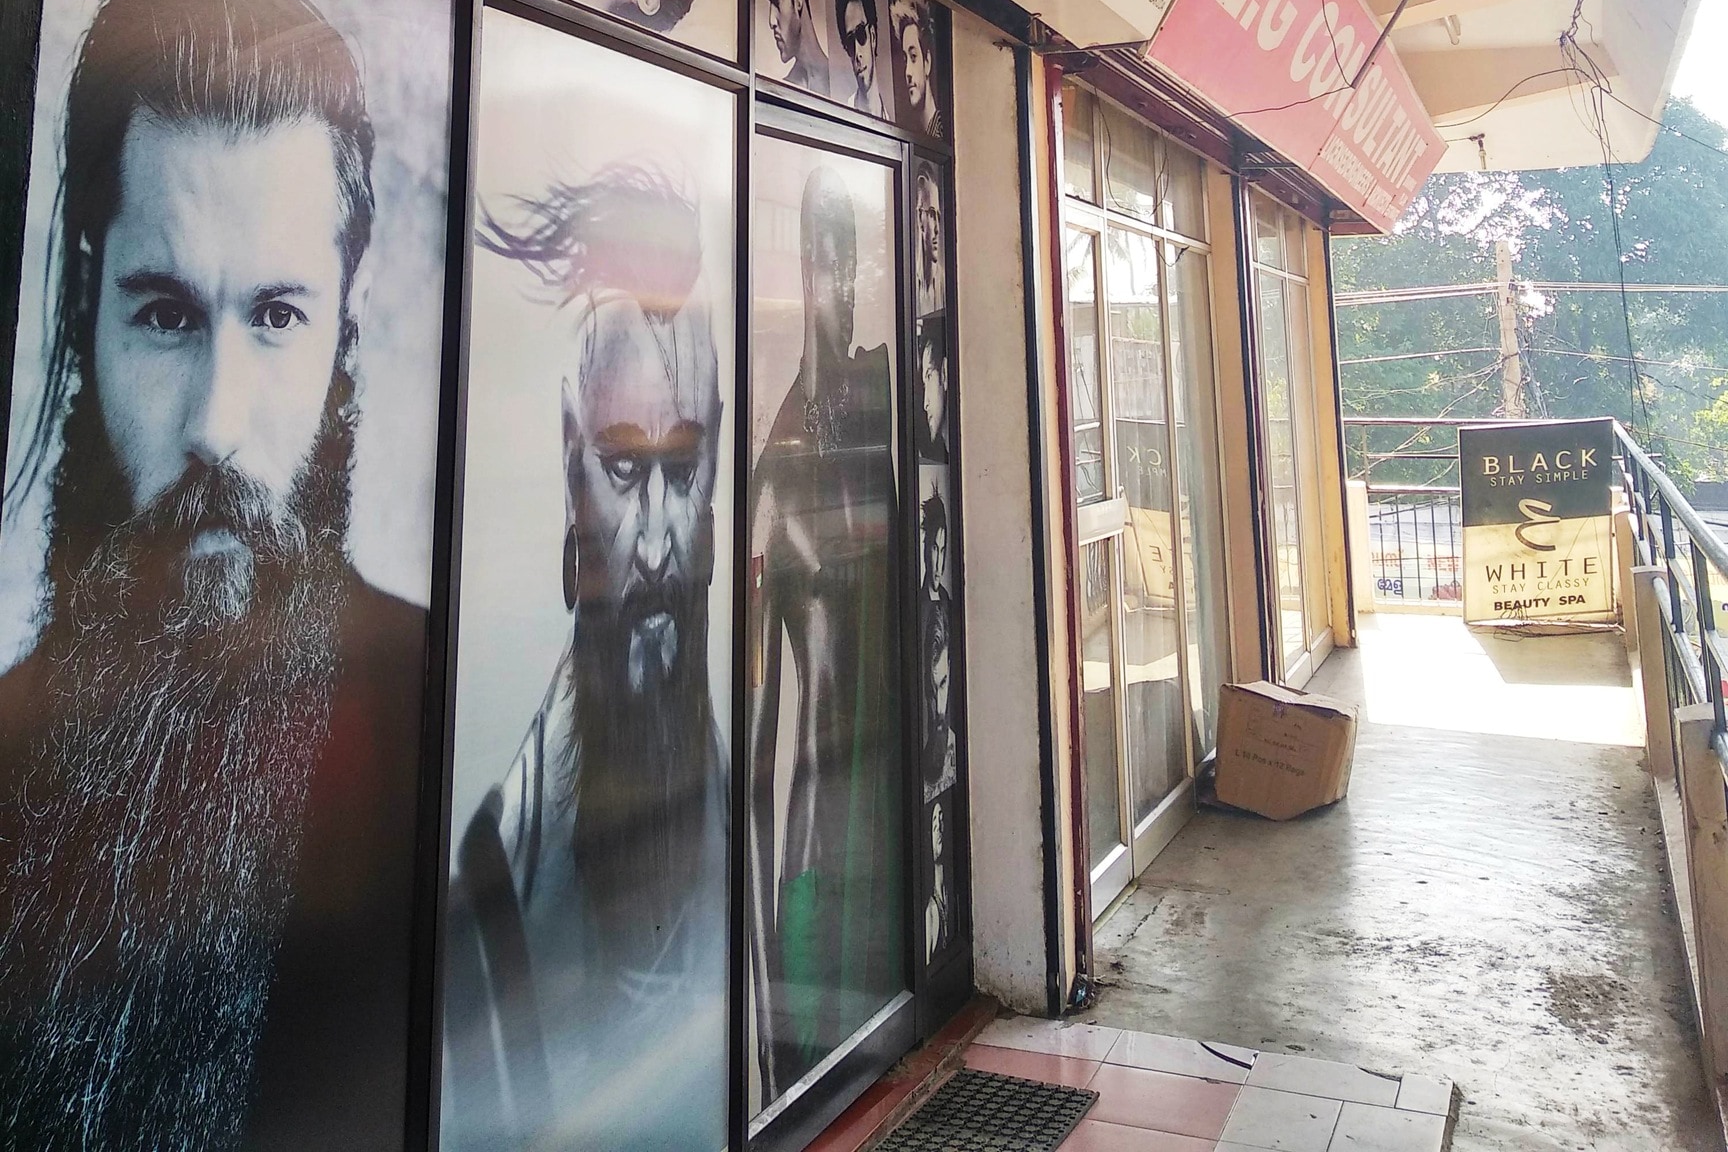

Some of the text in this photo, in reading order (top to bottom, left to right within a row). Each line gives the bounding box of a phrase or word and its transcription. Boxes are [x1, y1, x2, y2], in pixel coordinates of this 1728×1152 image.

[1483, 448, 1598, 476] BLACK
[1490, 470, 1589, 487] STAY SIMPLE
[1486, 557, 1598, 582] WHITE
[1492, 578, 1590, 594] STAY CLASSY
[1494, 596, 1586, 611] BEAUTY SPA
